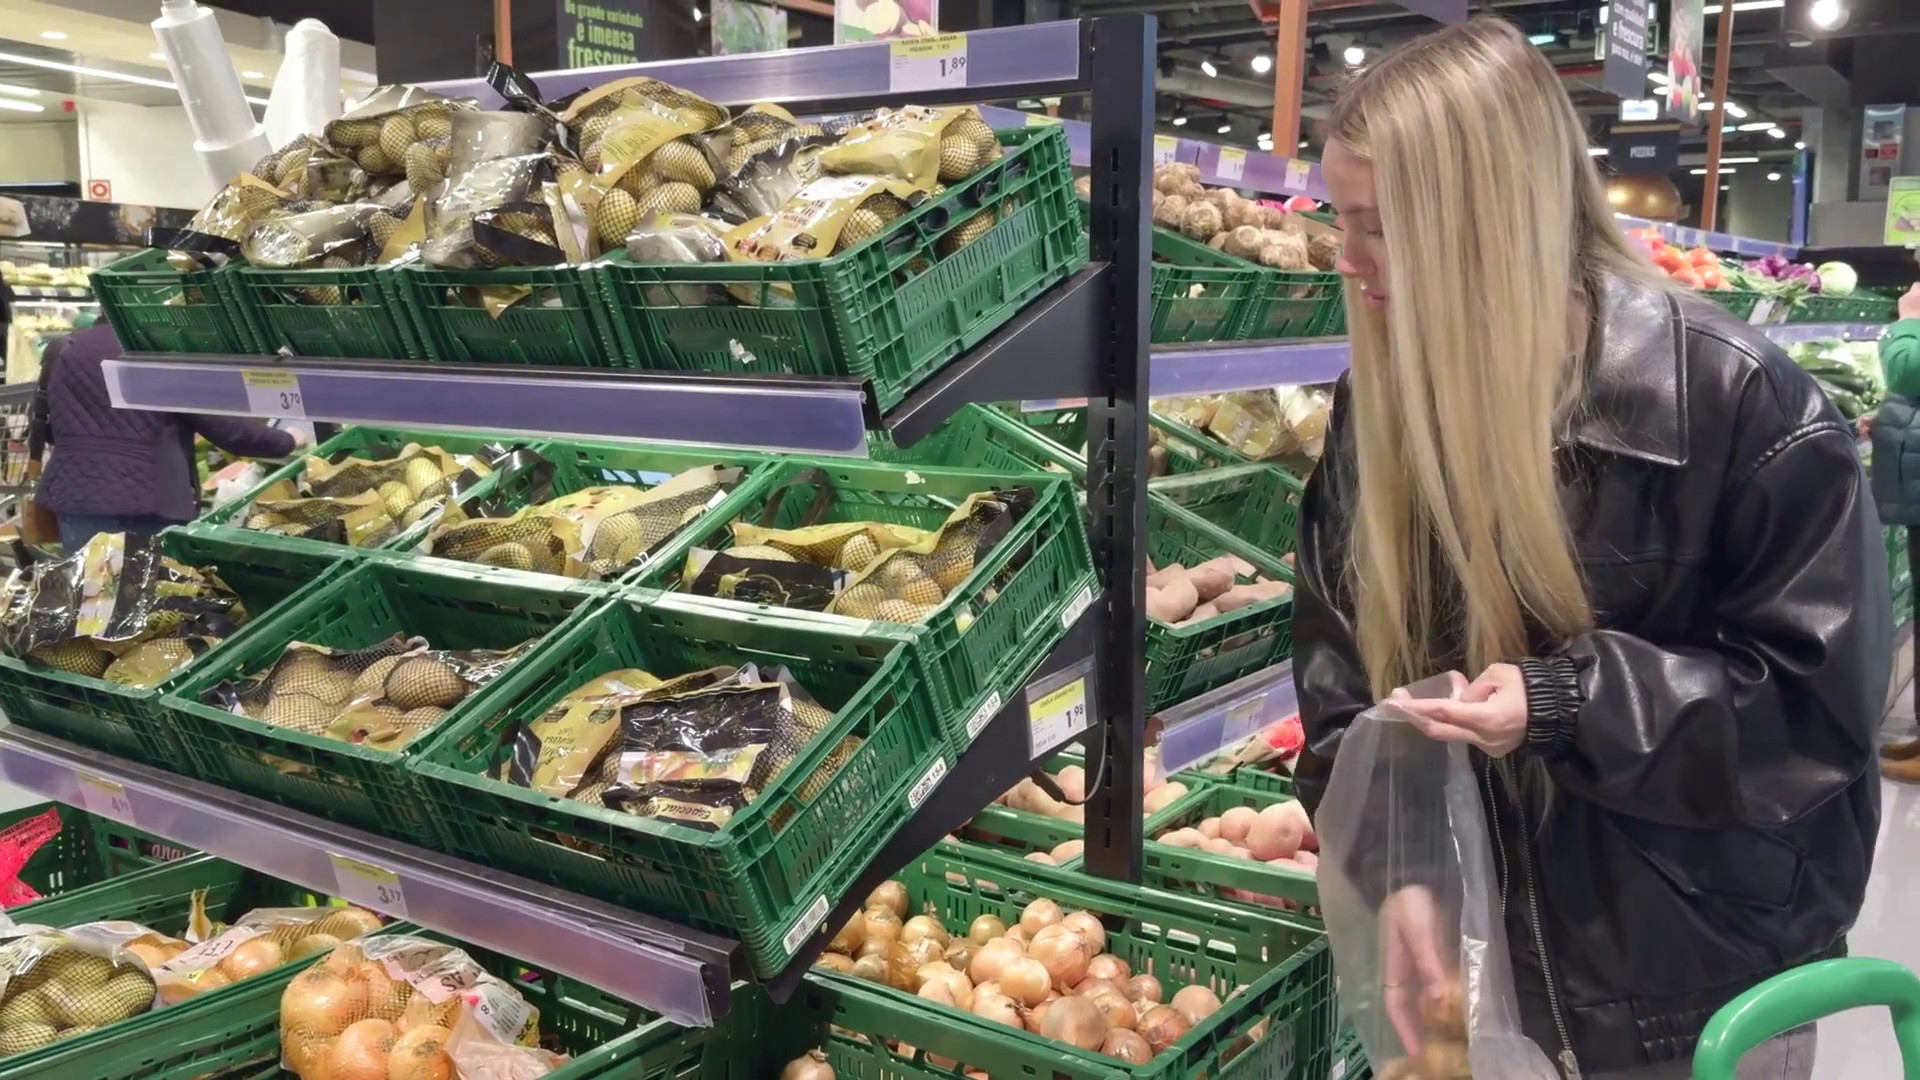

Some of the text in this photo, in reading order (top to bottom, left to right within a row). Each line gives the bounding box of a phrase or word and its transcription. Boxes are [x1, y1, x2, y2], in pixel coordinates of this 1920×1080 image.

[576, 19, 634, 51] e imensa
[939, 56, 966, 77] 1,89
